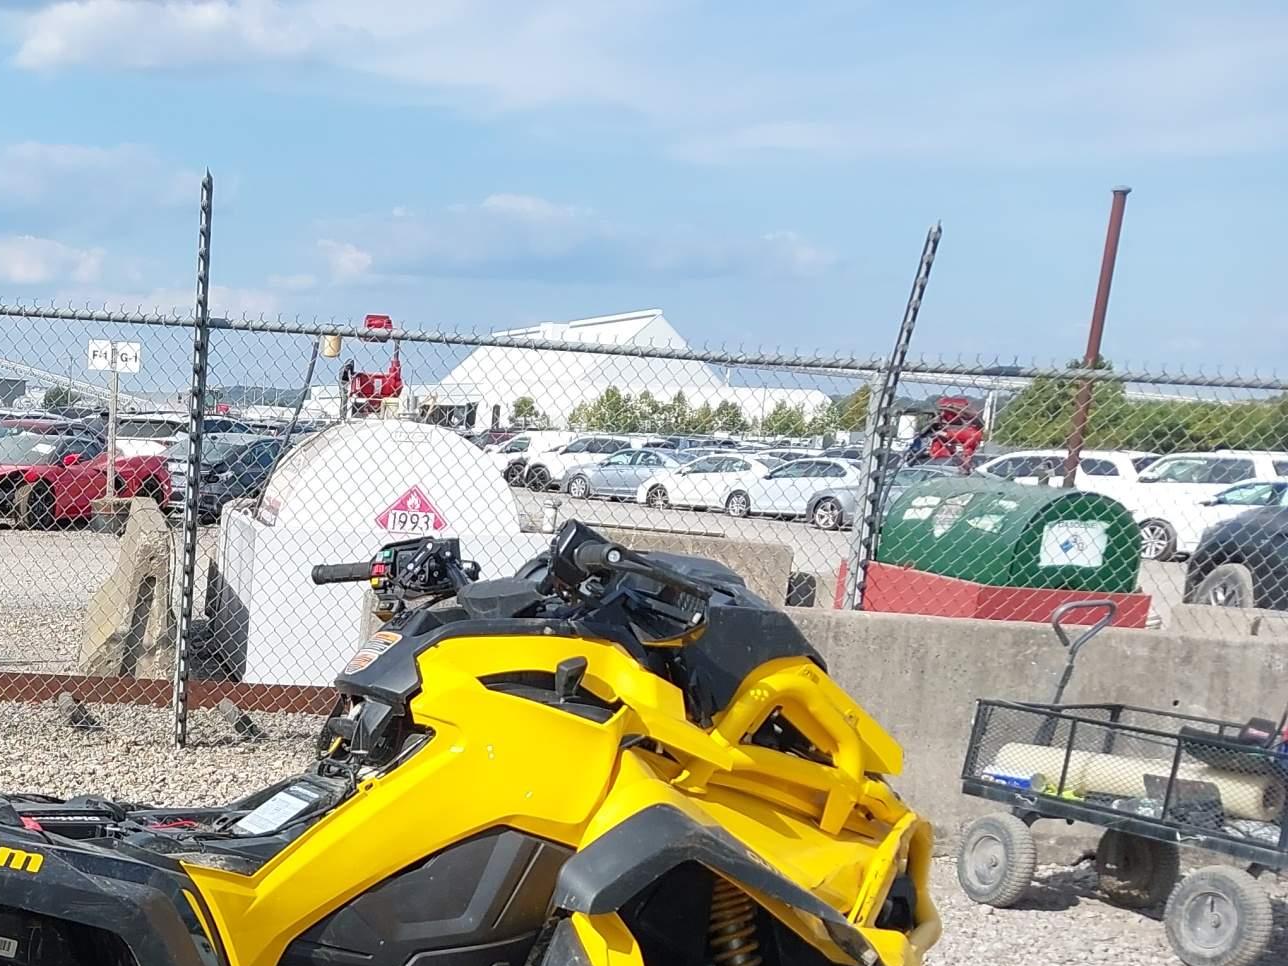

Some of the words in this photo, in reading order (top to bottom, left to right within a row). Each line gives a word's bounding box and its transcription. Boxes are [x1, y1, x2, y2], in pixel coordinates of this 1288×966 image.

[92, 350, 108, 360] F-1
[120, 352, 138, 362] G-1
[391, 512, 430, 531] 1993
